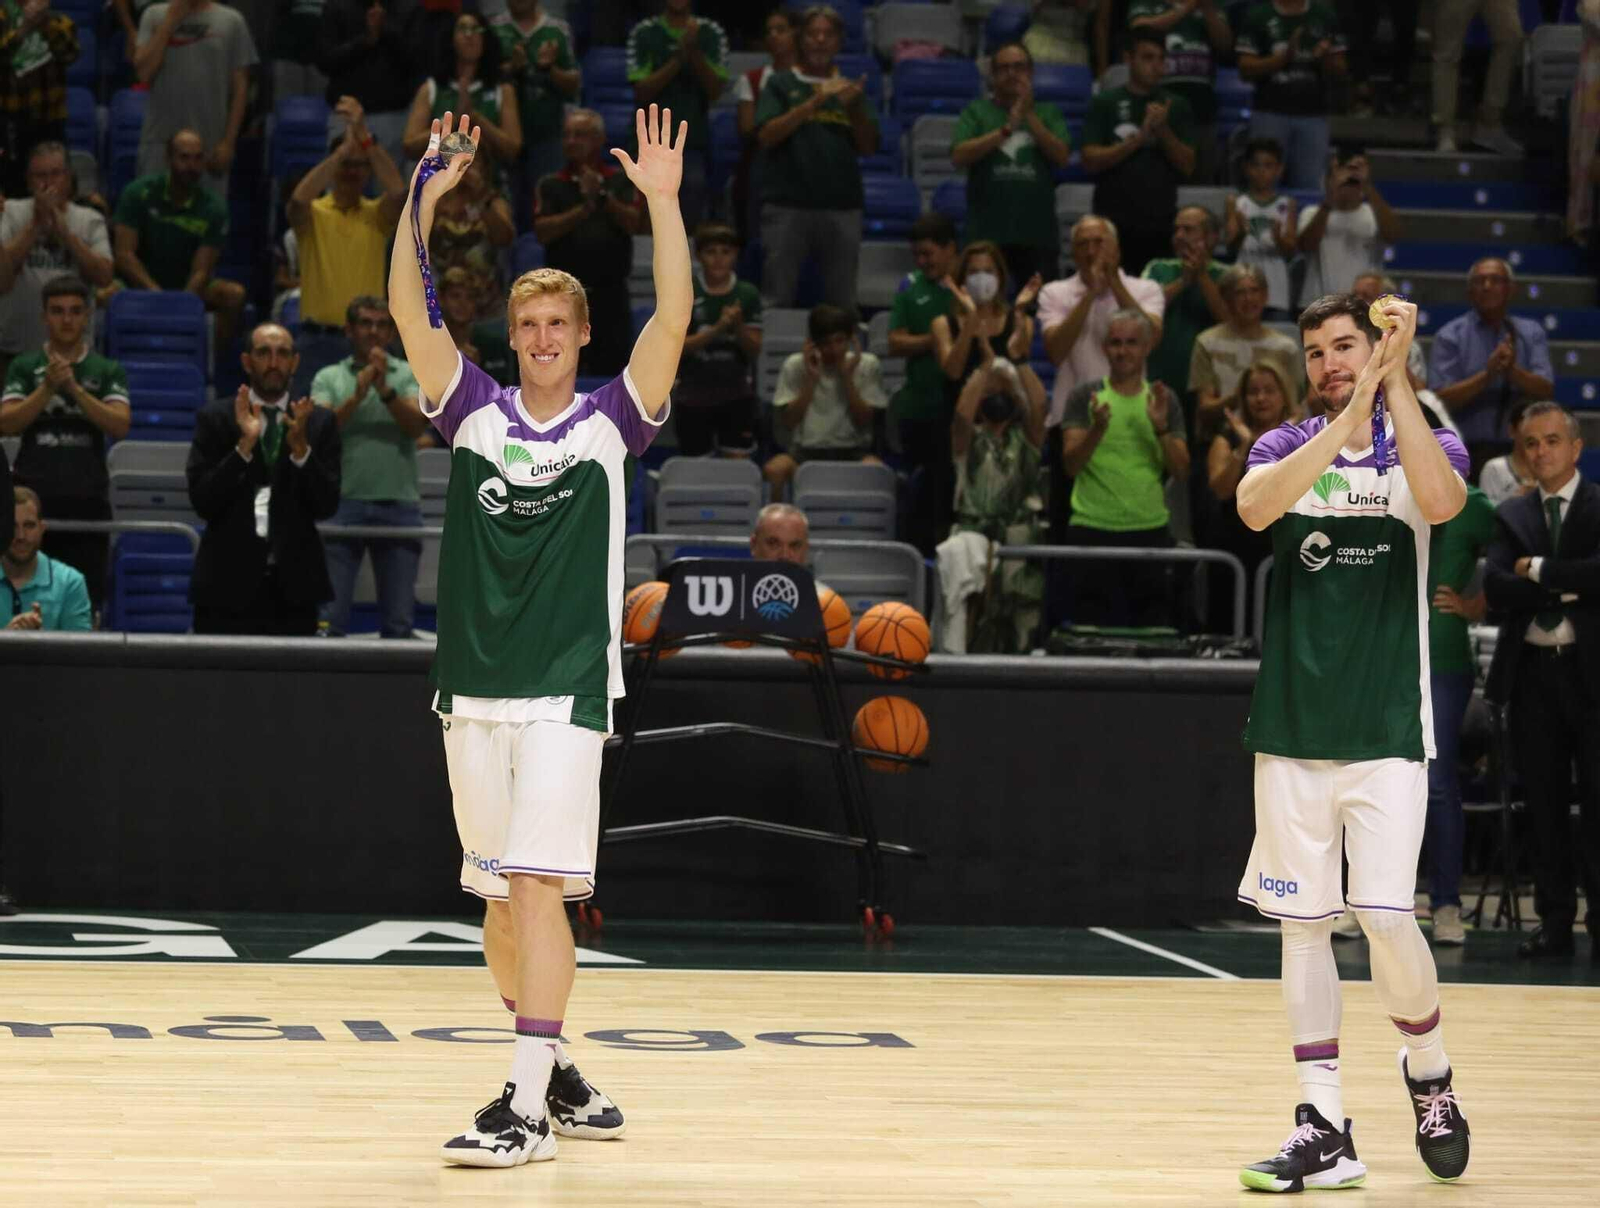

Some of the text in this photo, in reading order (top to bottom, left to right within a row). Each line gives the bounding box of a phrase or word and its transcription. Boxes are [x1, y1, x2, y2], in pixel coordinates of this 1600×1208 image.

[513, 500, 541, 509] COSTA
[1337, 547, 1366, 556] COSTA
[1376, 544, 1391, 552] SO
